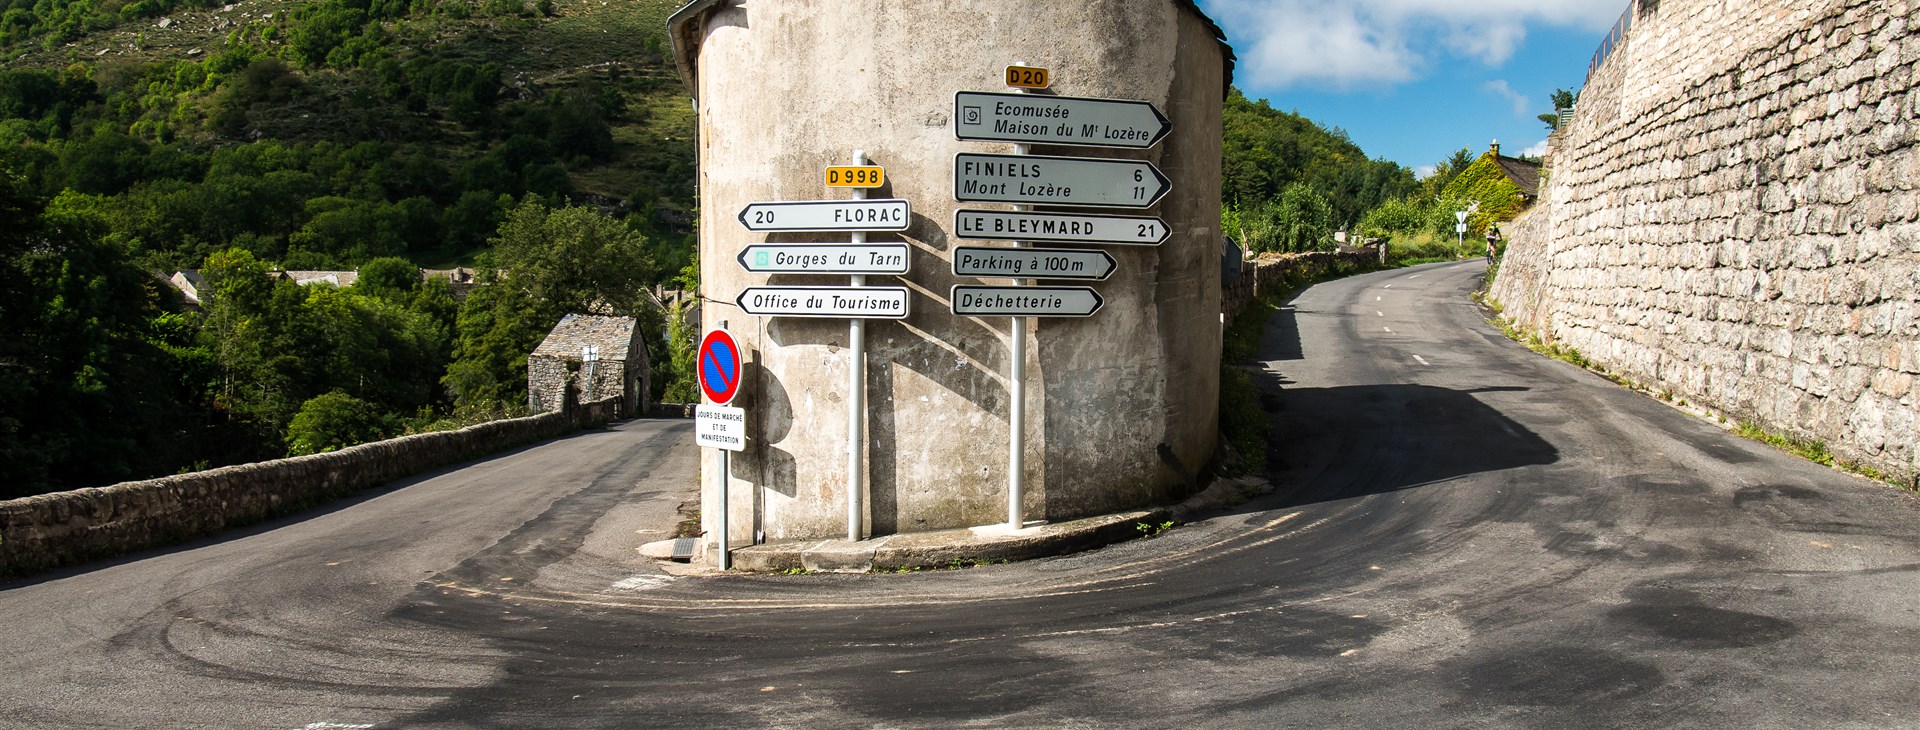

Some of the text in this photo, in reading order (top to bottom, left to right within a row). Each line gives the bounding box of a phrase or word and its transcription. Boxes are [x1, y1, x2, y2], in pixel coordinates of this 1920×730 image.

[1011, 70, 1043, 85] D 20
[995, 102, 1069, 119] Ecomusée
[994, 120, 1048, 136] Maison
[1057, 123, 1073, 137] du
[1105, 126, 1149, 141] Lozère
[830, 170, 878, 183] D 998
[965, 162, 1142, 182] FINIELS 6
[964, 180, 1145, 200] Mont Lozère 11
[756, 208, 901, 223] 20 FLORAC
[964, 218, 1155, 237] LE BLEYMARD 21
[776, 252, 901, 268] Gorges du Tarn
[962, 255, 1022, 273] Parking
[1030, 257, 1037, 270] à
[754, 295, 900, 310] Office du Tourisme
[962, 294, 1062, 309] Déchetterie
[701, 434, 739, 444] MANIFESTATION
